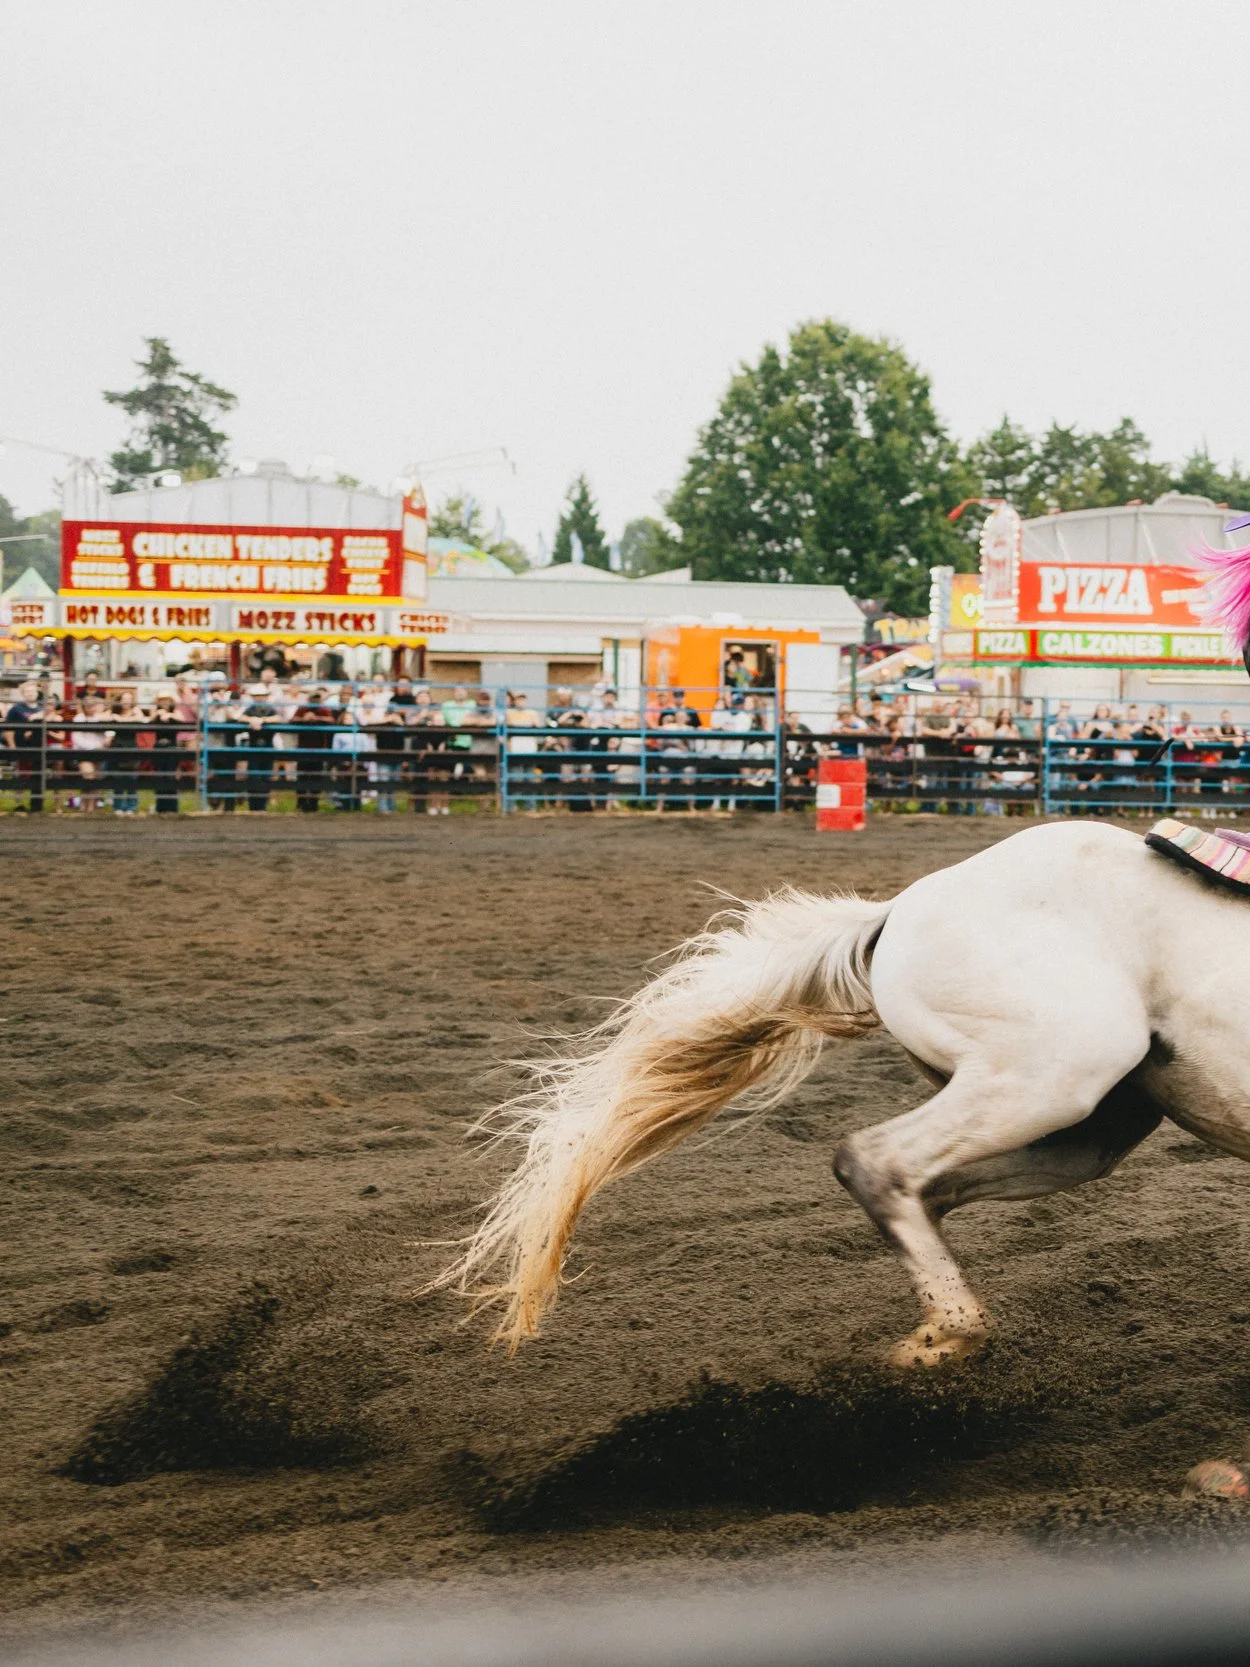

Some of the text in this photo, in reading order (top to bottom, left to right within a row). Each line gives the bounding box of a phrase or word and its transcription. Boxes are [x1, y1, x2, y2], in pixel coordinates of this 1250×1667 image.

[132, 532, 233, 559] CHICKEN
[235, 534, 334, 562] TENDERS
[169, 563, 259, 590] FRENCH
[262, 566, 328, 592] FRIES
[1037, 567, 1153, 615] PIZZA
[66, 605, 99, 625] HOT
[106, 606, 145, 626] DOGS
[166, 607, 210, 626] FRIES
[238, 610, 376, 632] MOZZ STICKS
[978, 632, 1028, 654] PIZZA
[1042, 633, 1164, 656] CALZONES
